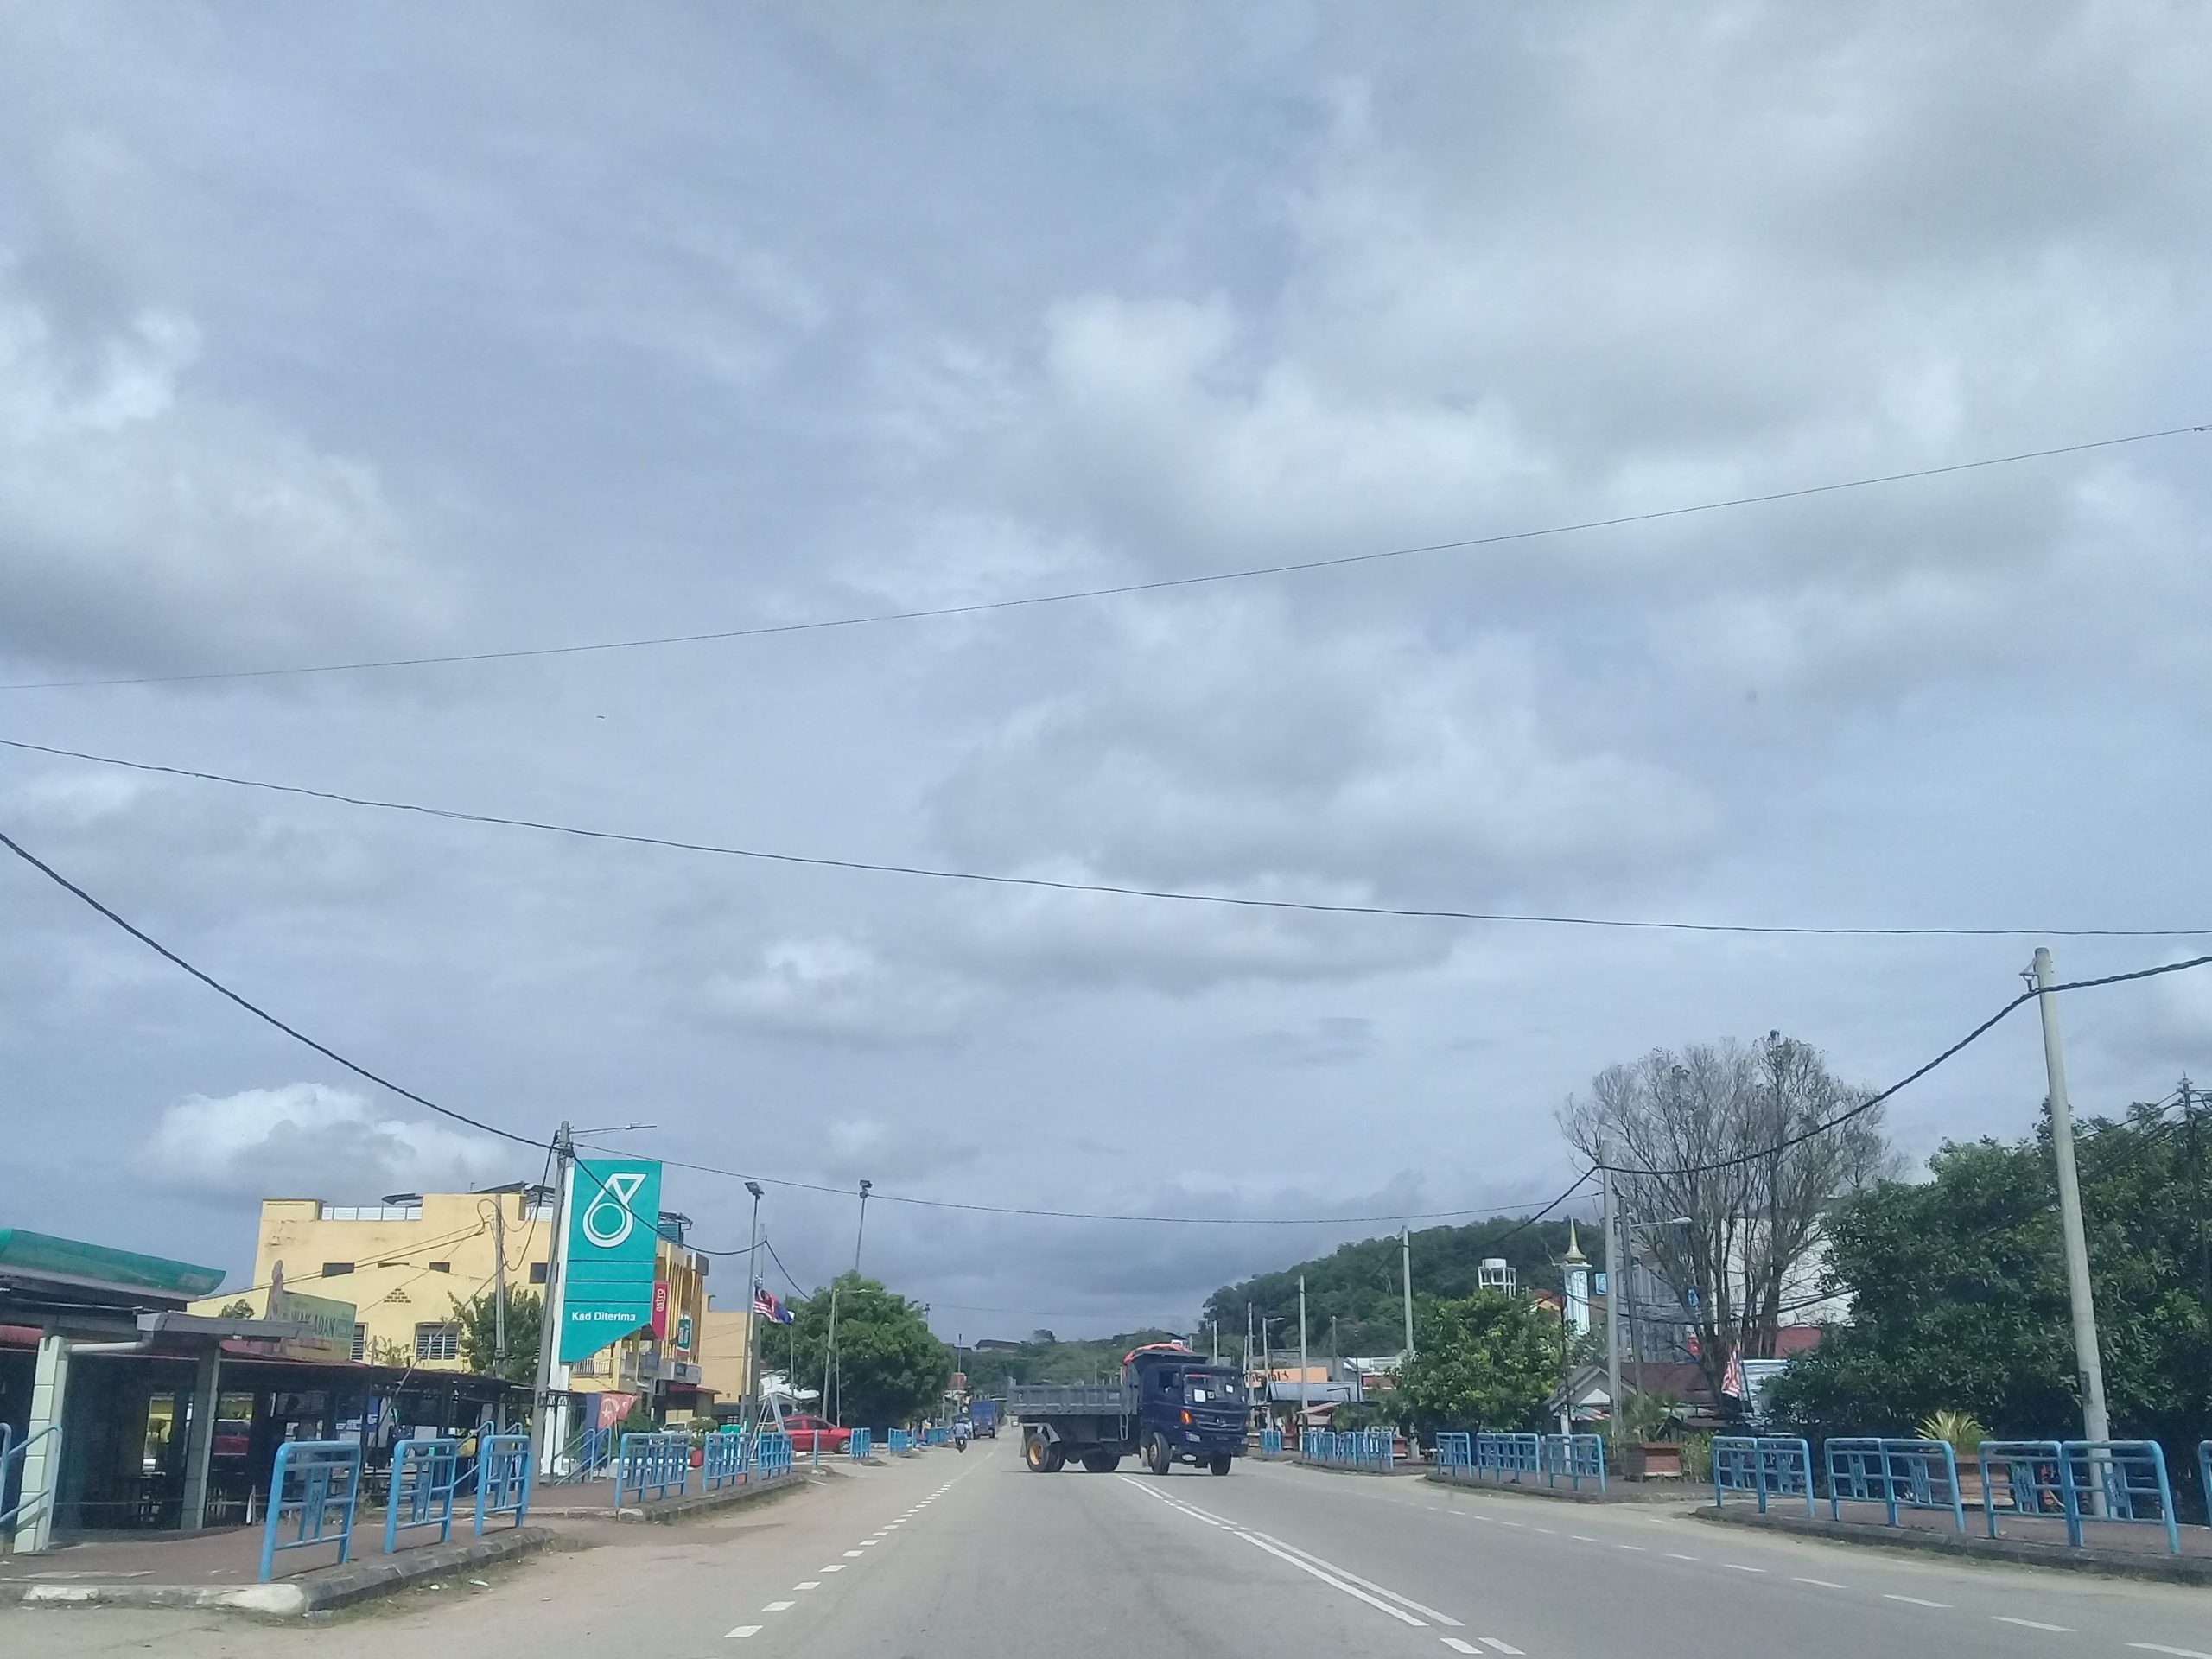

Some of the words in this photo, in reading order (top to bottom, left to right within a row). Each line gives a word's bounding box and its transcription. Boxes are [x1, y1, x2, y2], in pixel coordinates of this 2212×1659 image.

[655, 1288, 666, 1313] astro
[571, 1311, 592, 1321] Kad
[594, 1311, 636, 1322] Diterima
